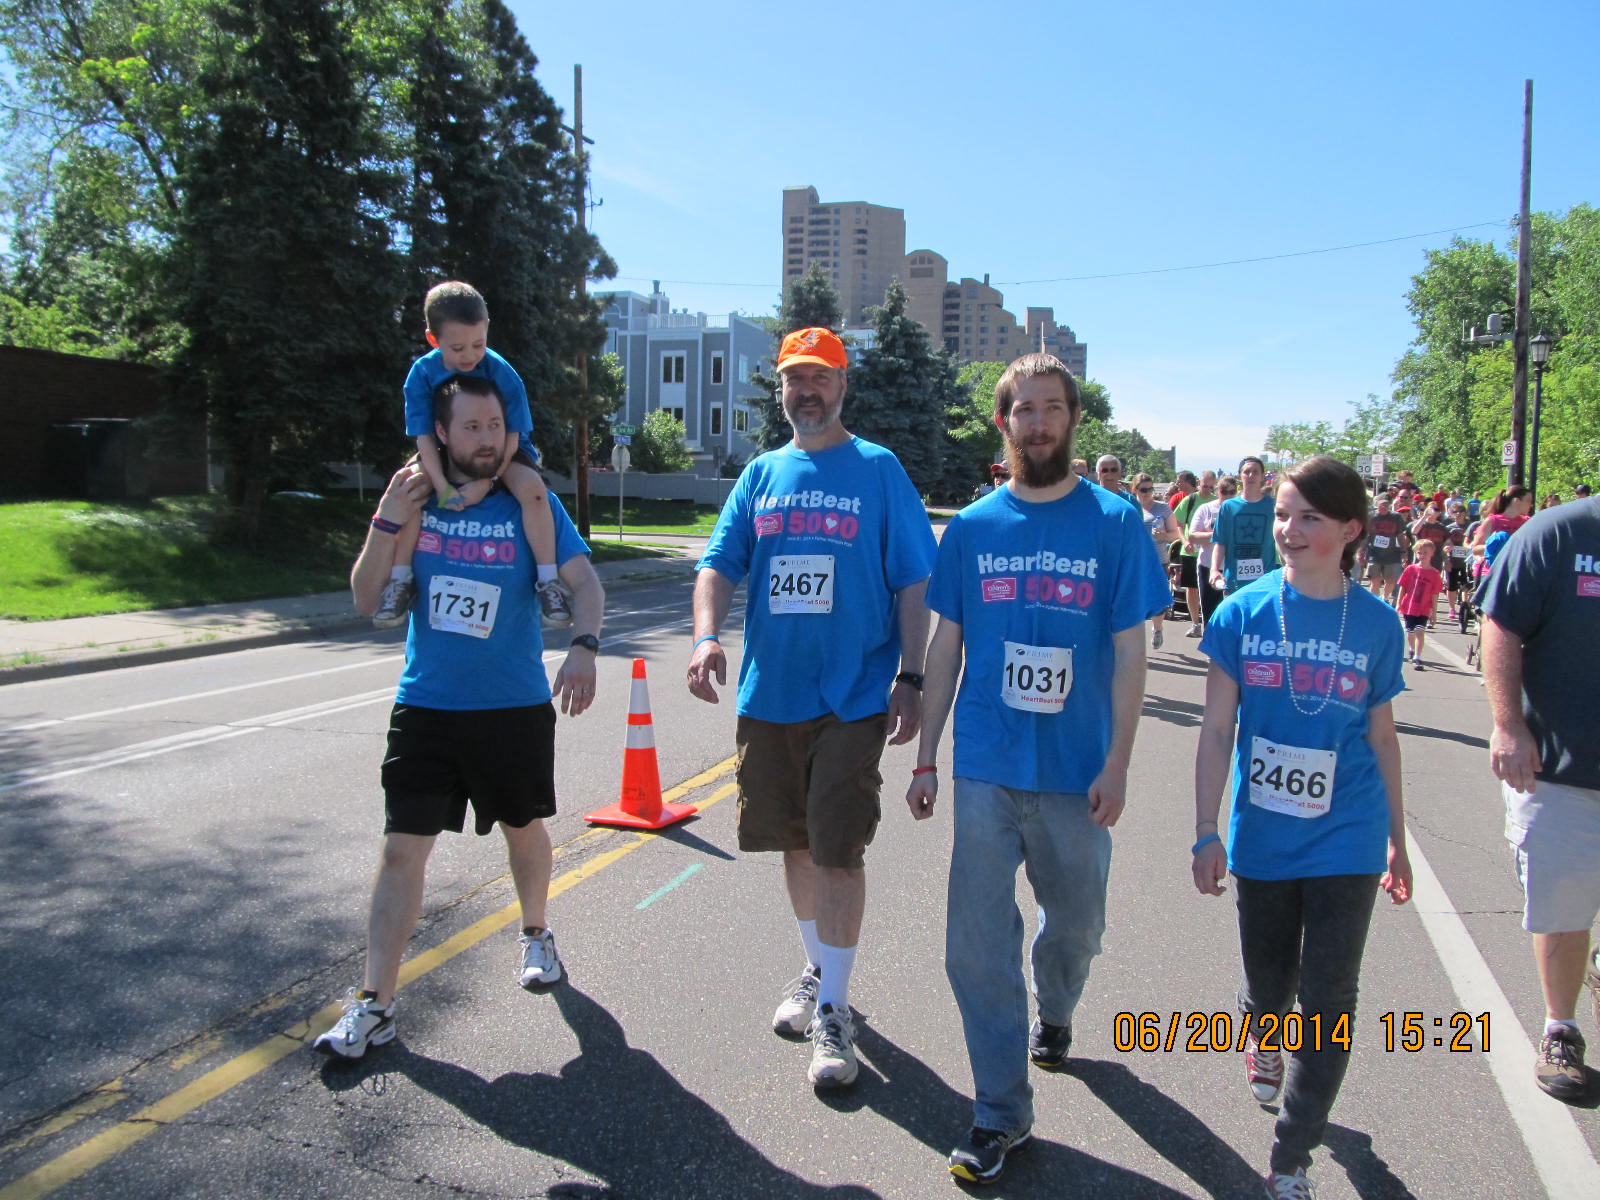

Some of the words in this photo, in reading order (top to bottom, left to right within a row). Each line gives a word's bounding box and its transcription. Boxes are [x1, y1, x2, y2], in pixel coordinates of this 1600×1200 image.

[1358, 465, 1371, 473] 30
[755, 490, 861, 514] HeartBeat
[977, 550, 1098, 579] HeartBeat
[1238, 565, 1262, 575] 2593
[770, 572, 829, 597] 2467
[432, 592, 490, 622] 1731
[1241, 633, 1370, 672] HeartBea
[1005, 662, 1067, 694] 1031
[1250, 757, 1328, 799] 2466
